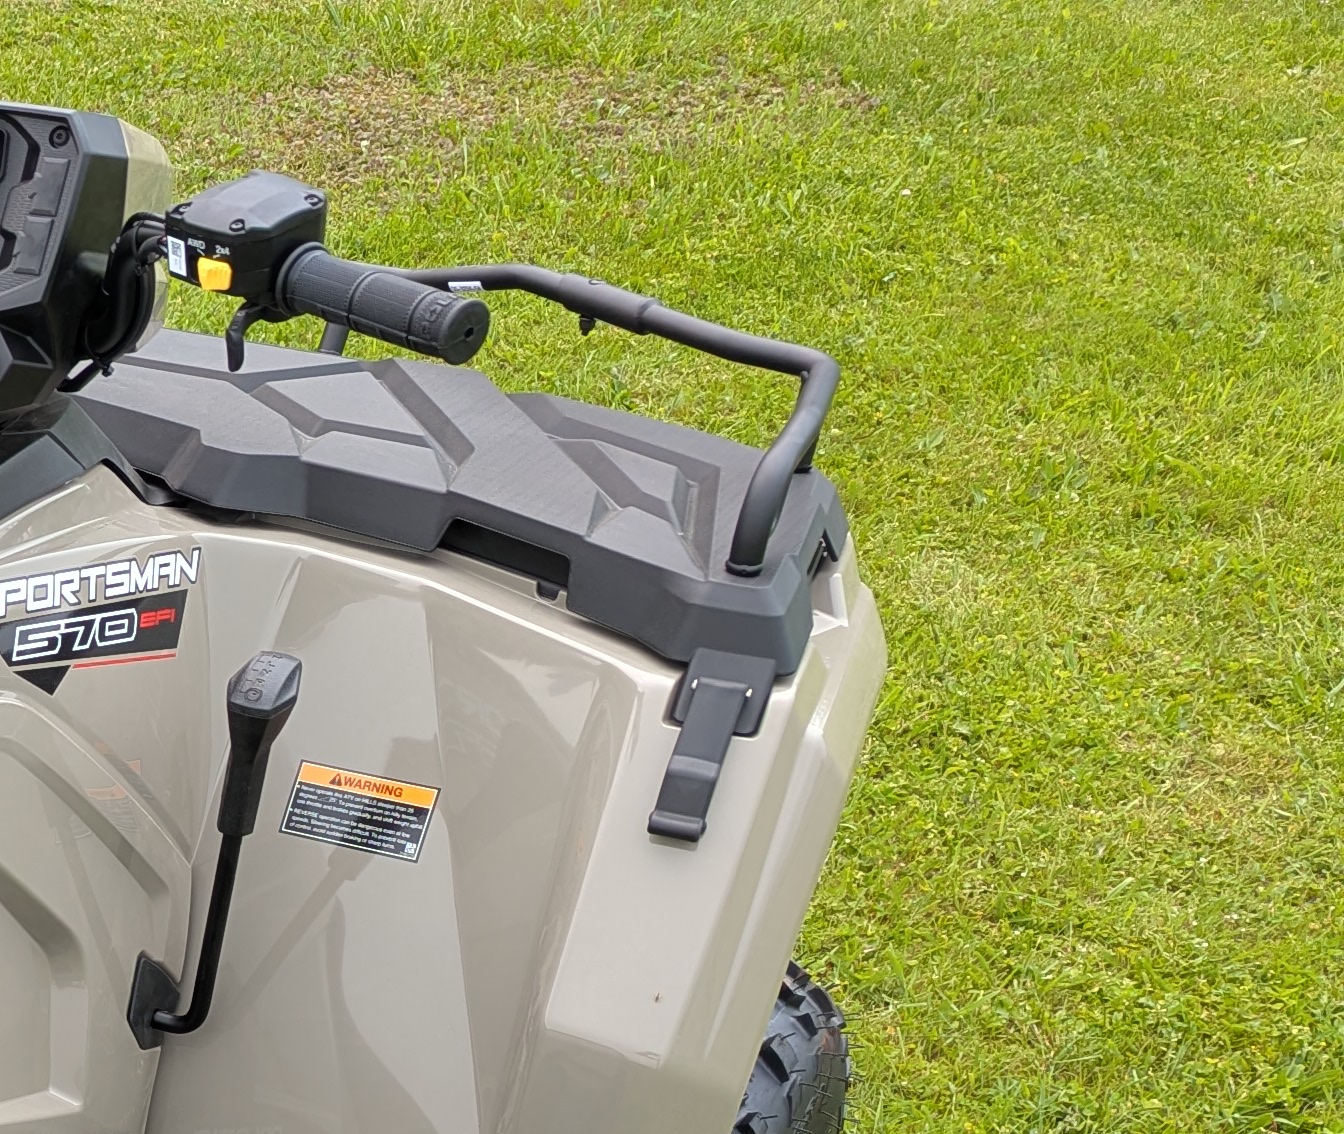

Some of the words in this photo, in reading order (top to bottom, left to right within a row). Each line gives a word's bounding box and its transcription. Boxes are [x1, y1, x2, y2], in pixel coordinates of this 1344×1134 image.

[12, 608, 138, 661] 570
[140, 608, 176, 628] EFI
[344, 776, 403, 798] WARNING
